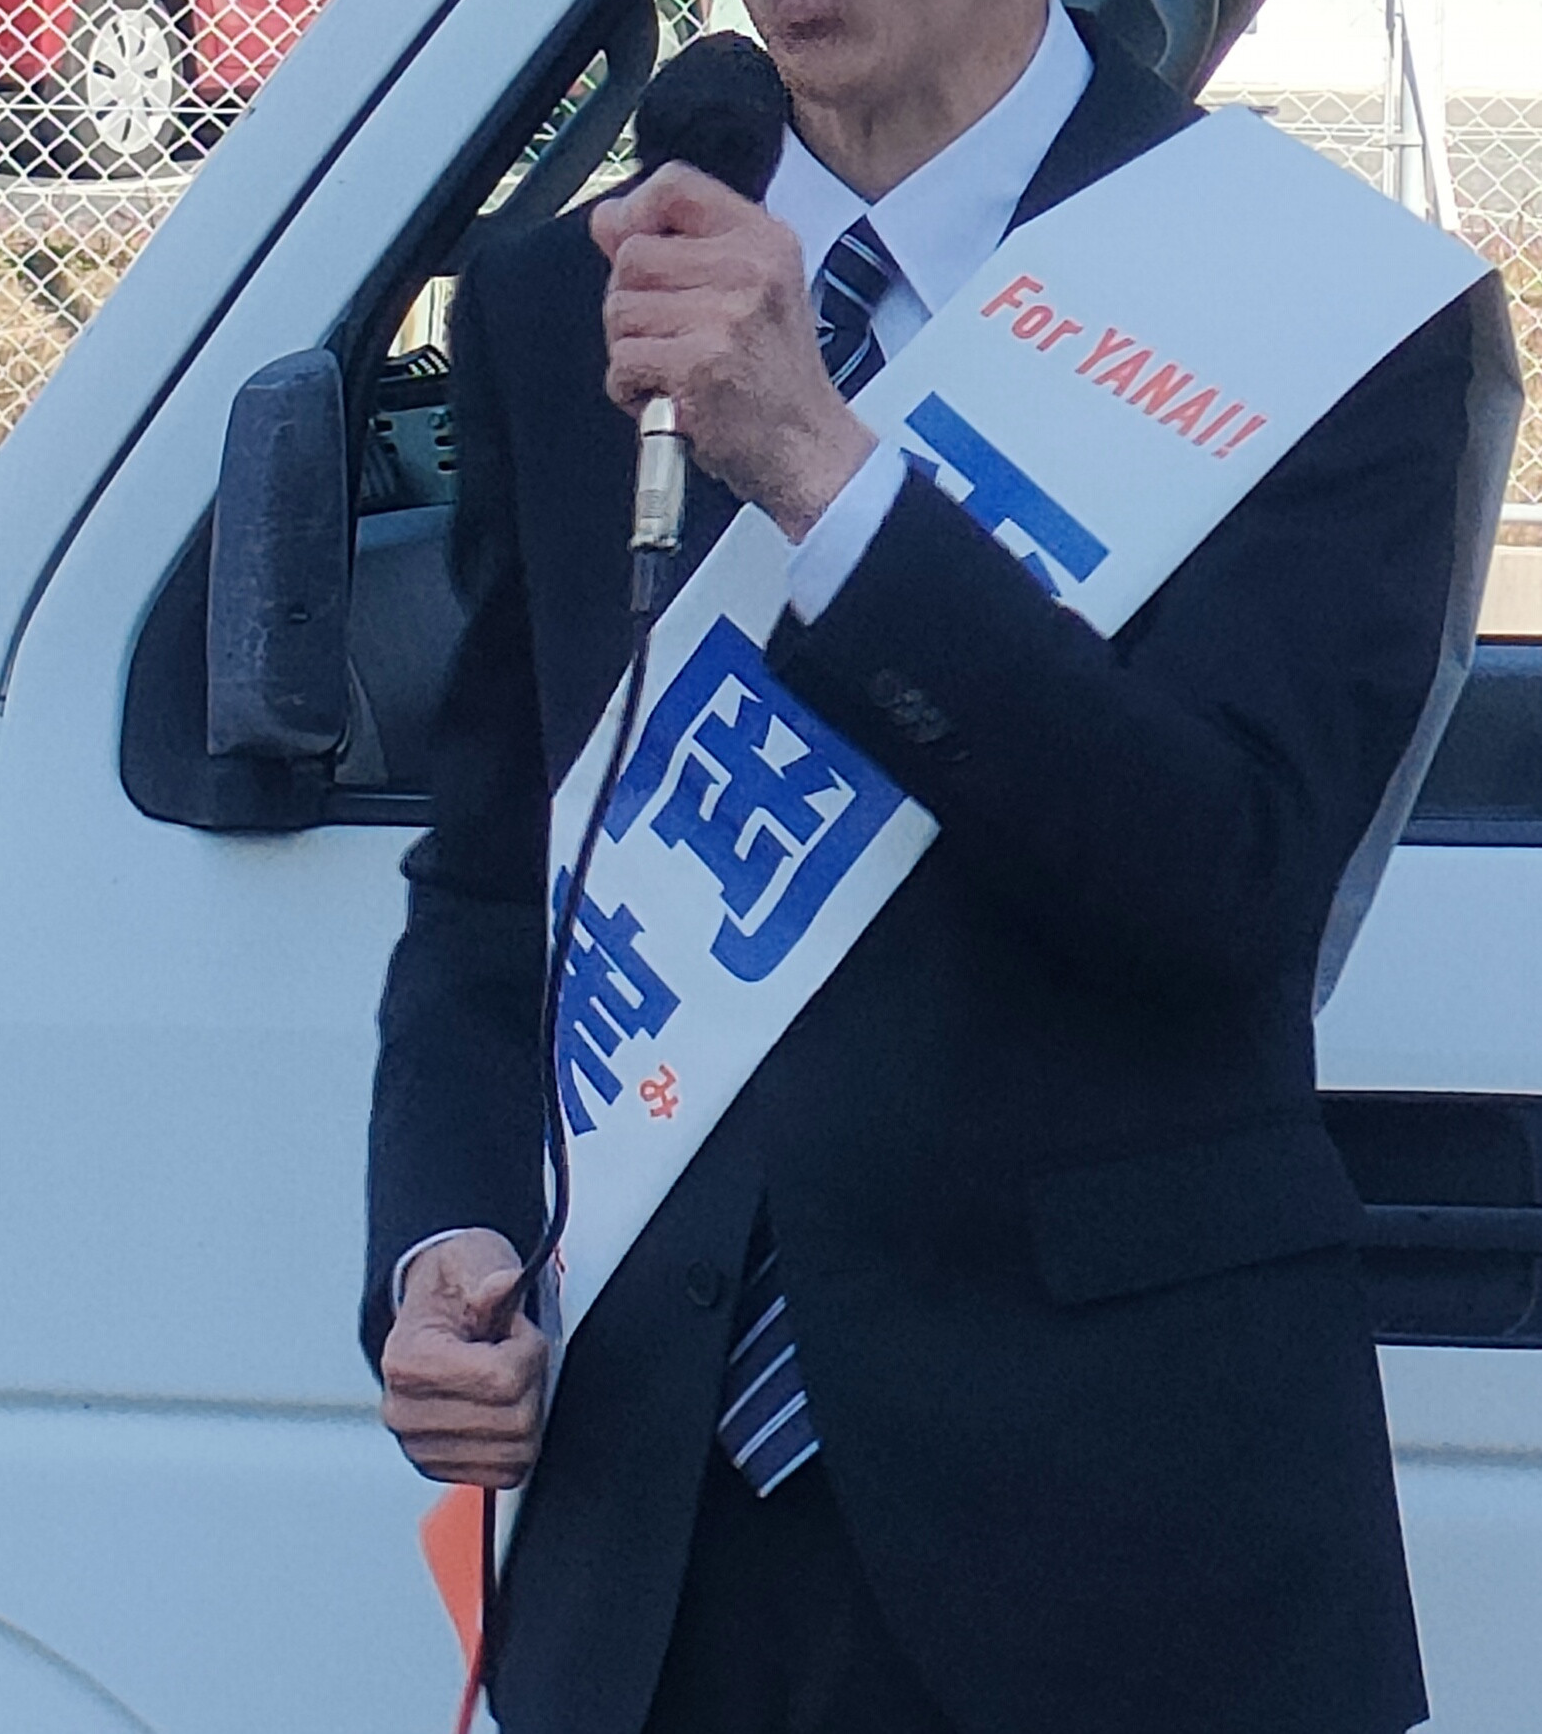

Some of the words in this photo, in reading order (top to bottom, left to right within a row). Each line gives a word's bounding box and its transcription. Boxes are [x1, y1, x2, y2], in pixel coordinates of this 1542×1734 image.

[981, 276, 1083, 351] For
[1075, 328, 1267, 458] YANAI!
[639, 1064, 678, 1119] み
